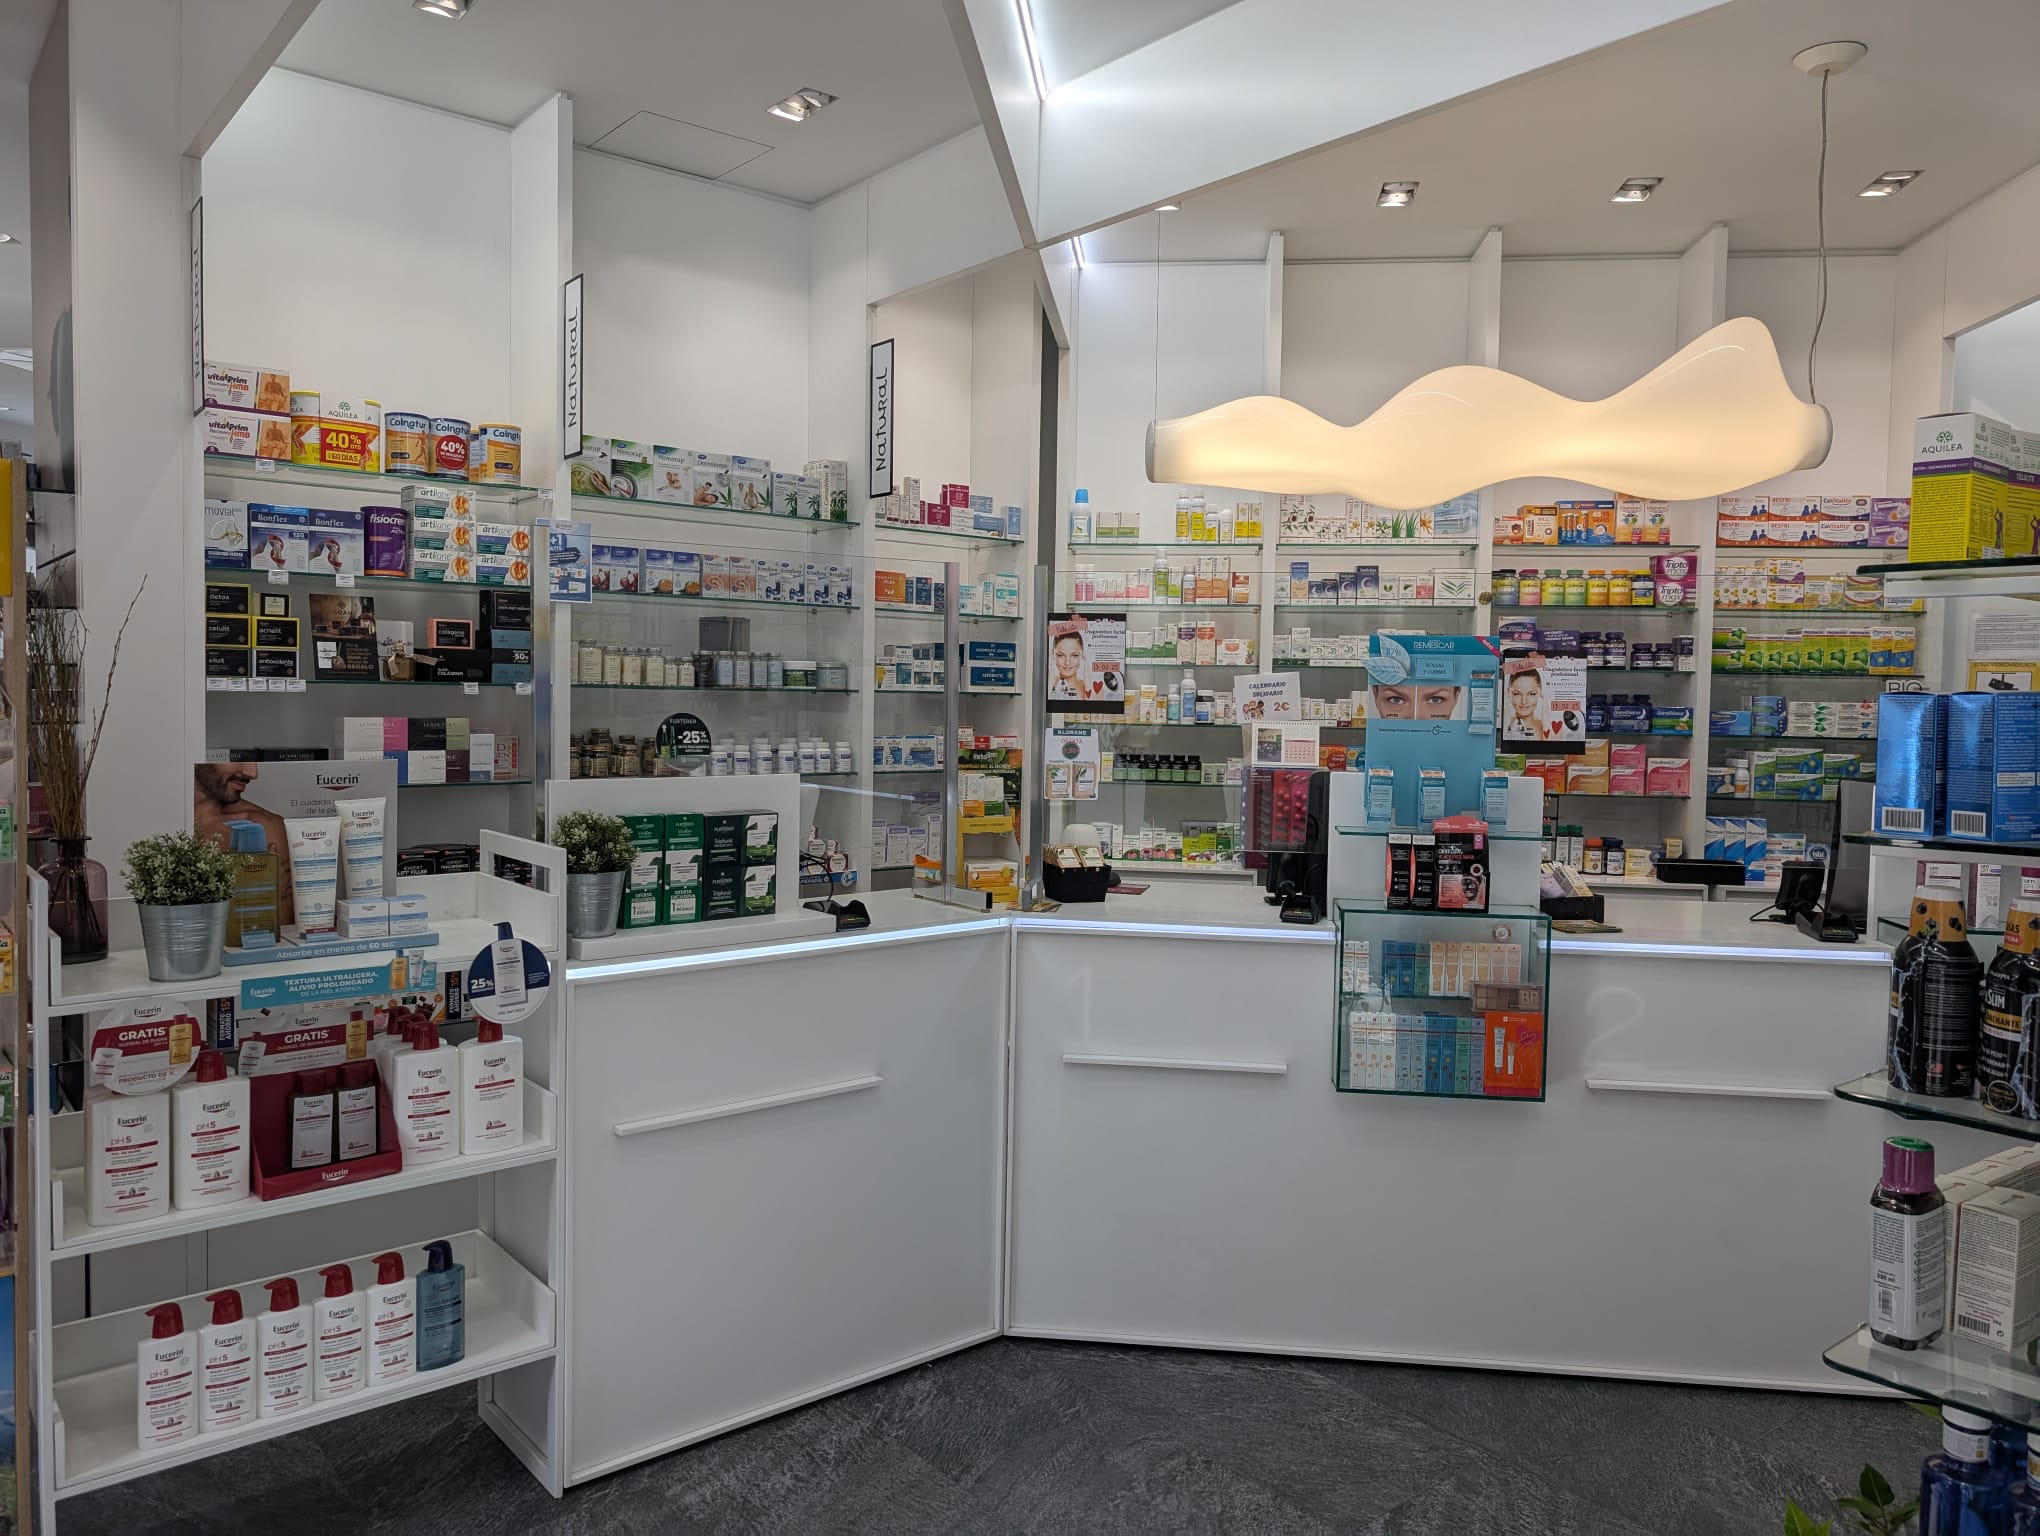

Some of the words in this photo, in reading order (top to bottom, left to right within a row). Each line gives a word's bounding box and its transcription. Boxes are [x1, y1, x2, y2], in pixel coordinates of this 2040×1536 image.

[328, 410, 358, 420] AQUILEA
[389, 417, 426, 430] Colnatur
[440, 441, 465, 453] 40%
[1921, 444, 1963, 455] AQUILEA
[258, 514, 288, 523] Bonflex
[315, 519, 345, 527] Bonflex
[1665, 559, 1688, 570] Tripto
[1659, 585, 1683, 596] Tripto
[1413, 641, 1455, 649] REMESCAR
[1249, 681, 1286, 689] CALENDARIO
[1274, 702, 1290, 711] 2€
[316, 774, 358, 785] Eucerin
[300, 799, 331, 807] cuidado
[352, 810, 375, 818] Eucerin
[301, 830, 326, 838] Eucerin
[276, 947, 312, 959] Absorbe
[326, 946, 354, 954] menos
[355, 943, 367, 951] de
[284, 976, 321, 986] TEXTURA
[289, 984, 316, 992] ALIVIO
[318, 978, 374, 989] PROLONGADO
[471, 979, 494, 990] 25%
[250, 986, 276, 996] Eucerin
[134, 1006, 162, 1016] Eucerin
[295, 1016, 319, 1025] Eucerin
[118, 1026, 166, 1041] GRATIS
[284, 1030, 329, 1044] GRATIS
[483, 1056, 507, 1066] Eucerin
[417, 1068, 442, 1078] Eucerin
[202, 1101, 230, 1111] Eucerin
[303, 1099, 324, 1107] Eucerin
[117, 1114, 148, 1125] Eucerin
[322, 1168, 349, 1180] Eucerin
[383, 1293, 407, 1303] Eucerin
[329, 1306, 355, 1317] Eucerin
[272, 1321, 300, 1333] Eucerin
[214, 1335, 243, 1345] Eucerin
[154, 1347, 184, 1361] Eucerin
